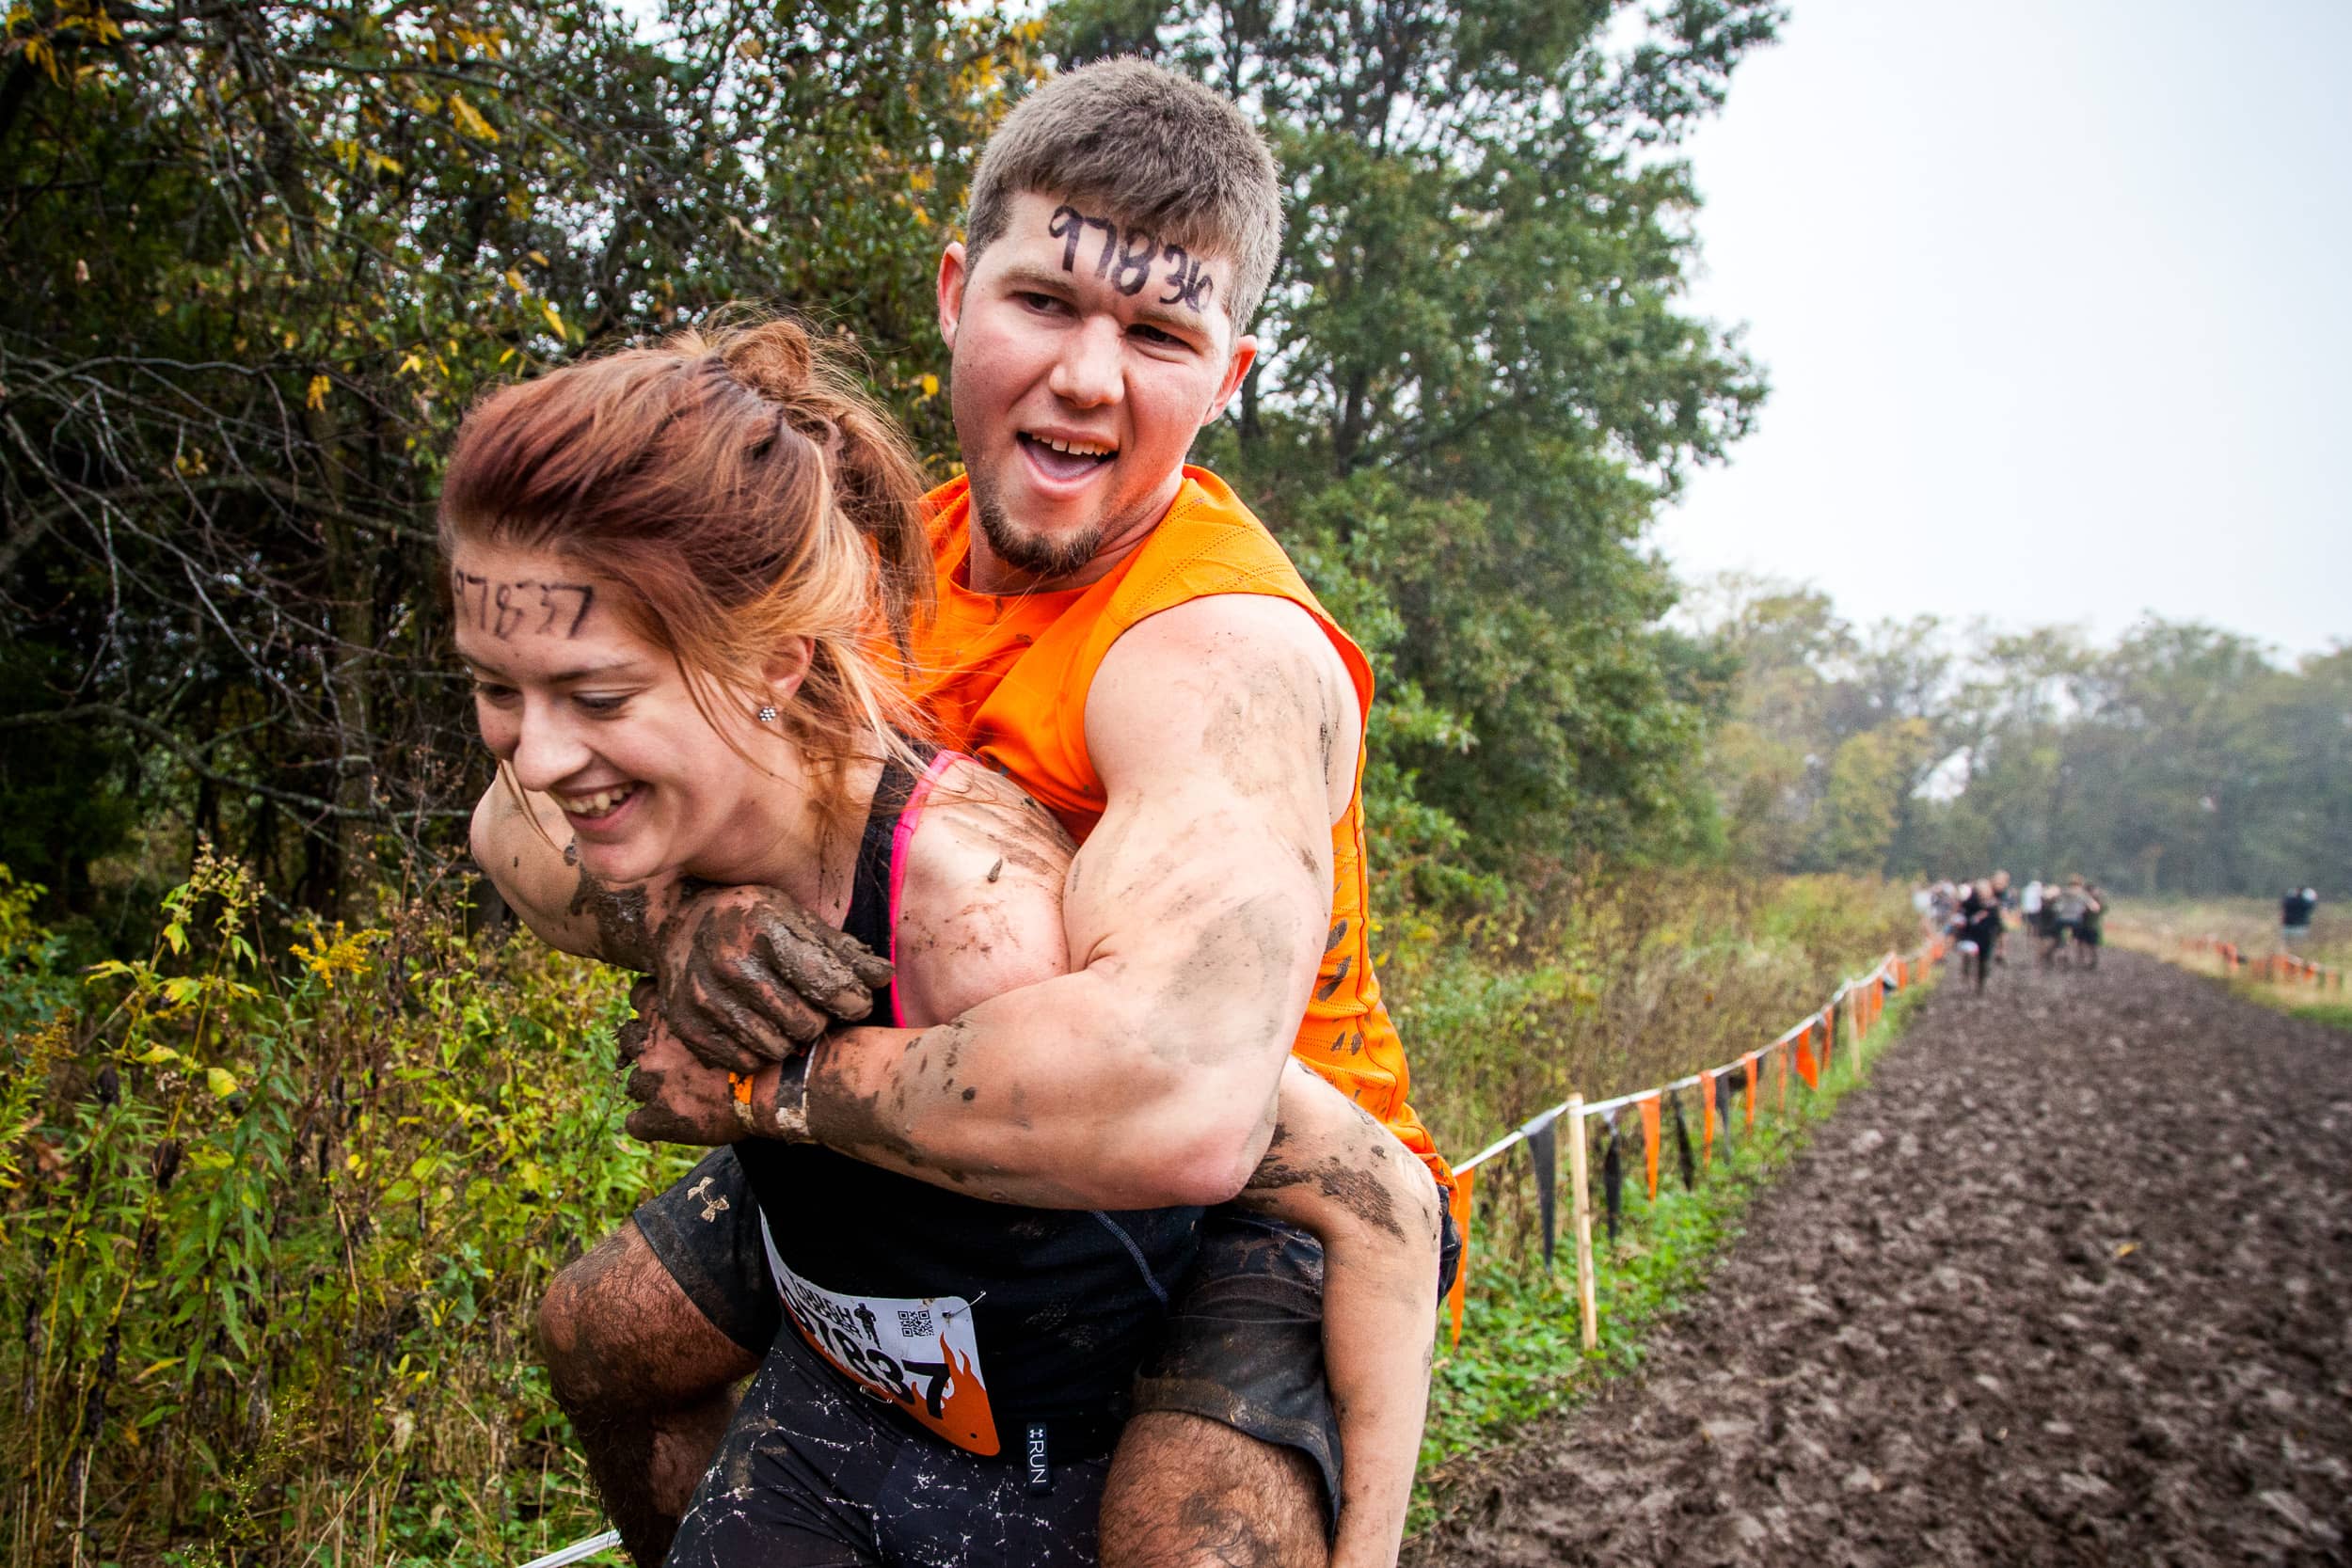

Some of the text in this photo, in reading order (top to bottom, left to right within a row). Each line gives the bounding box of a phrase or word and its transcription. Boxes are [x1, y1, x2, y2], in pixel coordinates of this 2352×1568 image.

[1048, 204, 1214, 312] 97836
[779, 1276, 950, 1419] 97837
[1029, 1440, 1046, 1483] RUN
